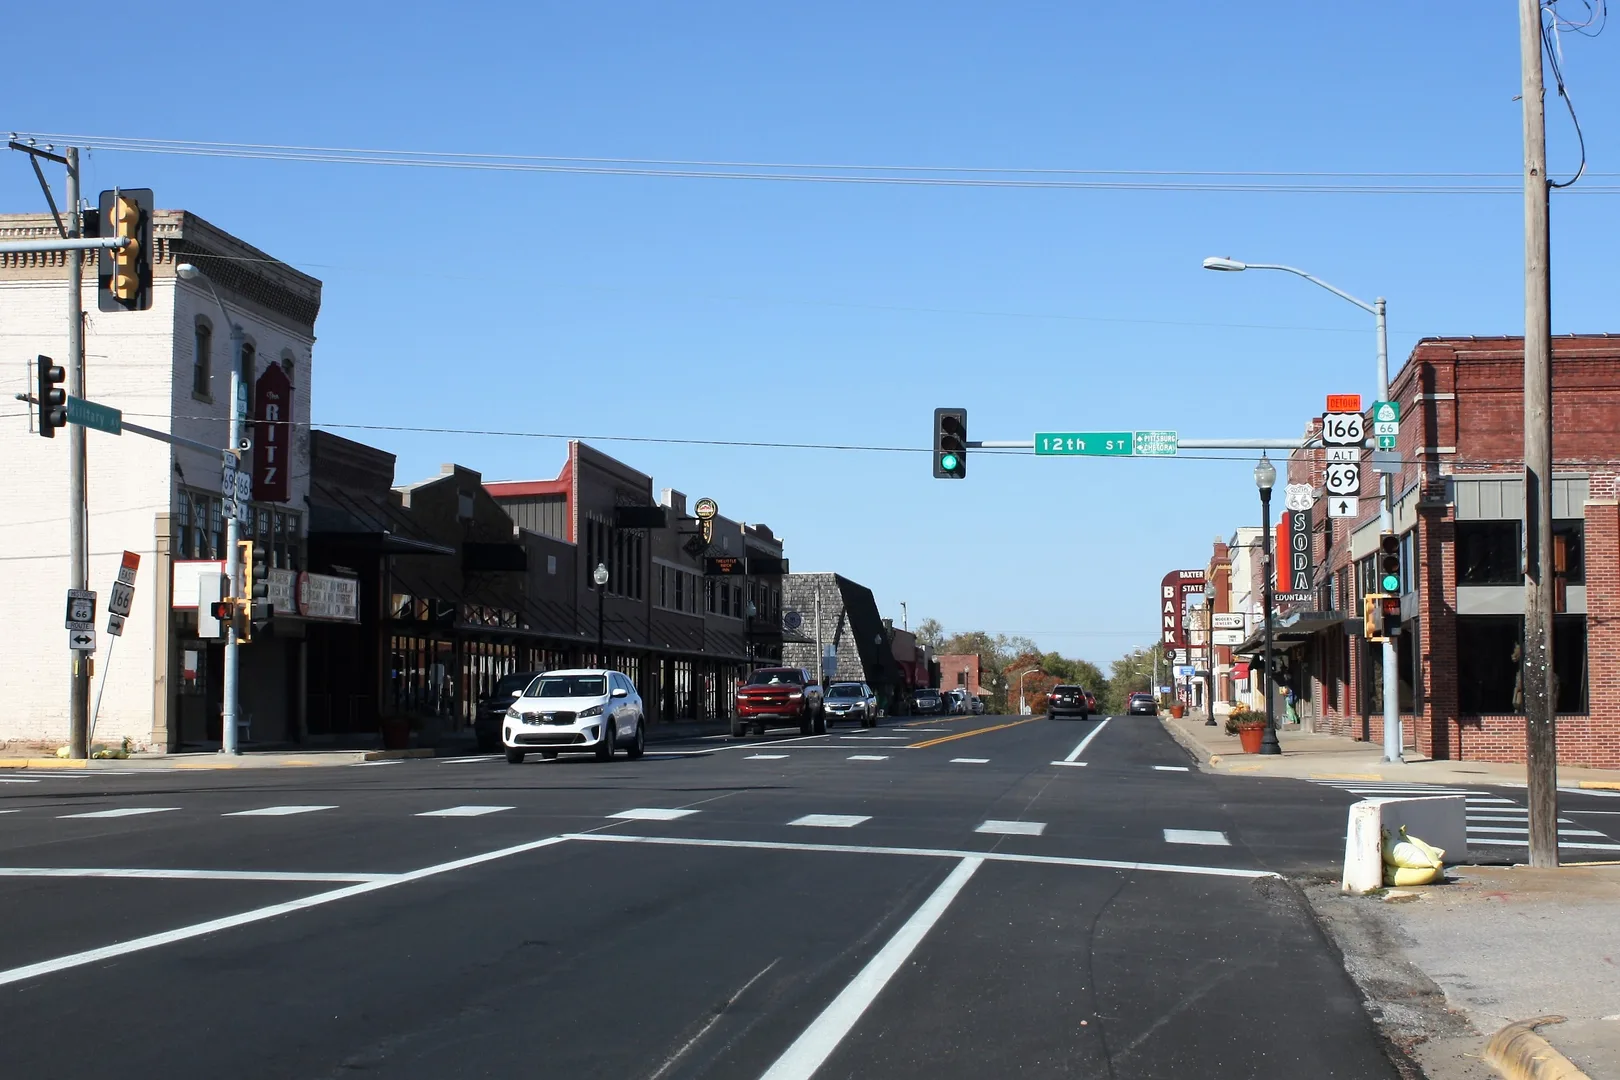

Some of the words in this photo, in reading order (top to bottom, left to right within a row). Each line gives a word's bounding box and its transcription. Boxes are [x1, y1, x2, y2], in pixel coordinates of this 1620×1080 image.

[1330, 399, 1357, 408] DETOUR
[1327, 420, 1359, 437] 166
[1380, 424, 1393, 433] 66
[264, 403, 279, 484] RITZ
[1043, 438, 1086, 451] 12th
[1105, 440, 1125, 450] ST
[1333, 451, 1353, 460] ALT
[224, 474, 234, 490] 69
[237, 476, 248, 495] 166
[1330, 469, 1355, 487] 69
[1290, 493, 1310, 508] 66
[1293, 513, 1308, 589] SODA
[121, 569, 134, 581] EAST
[113, 589, 130, 609] 166
[76, 610, 87, 618] 66
[1163, 586, 1175, 643] BANK
[70, 621, 90, 629] ROUTE
